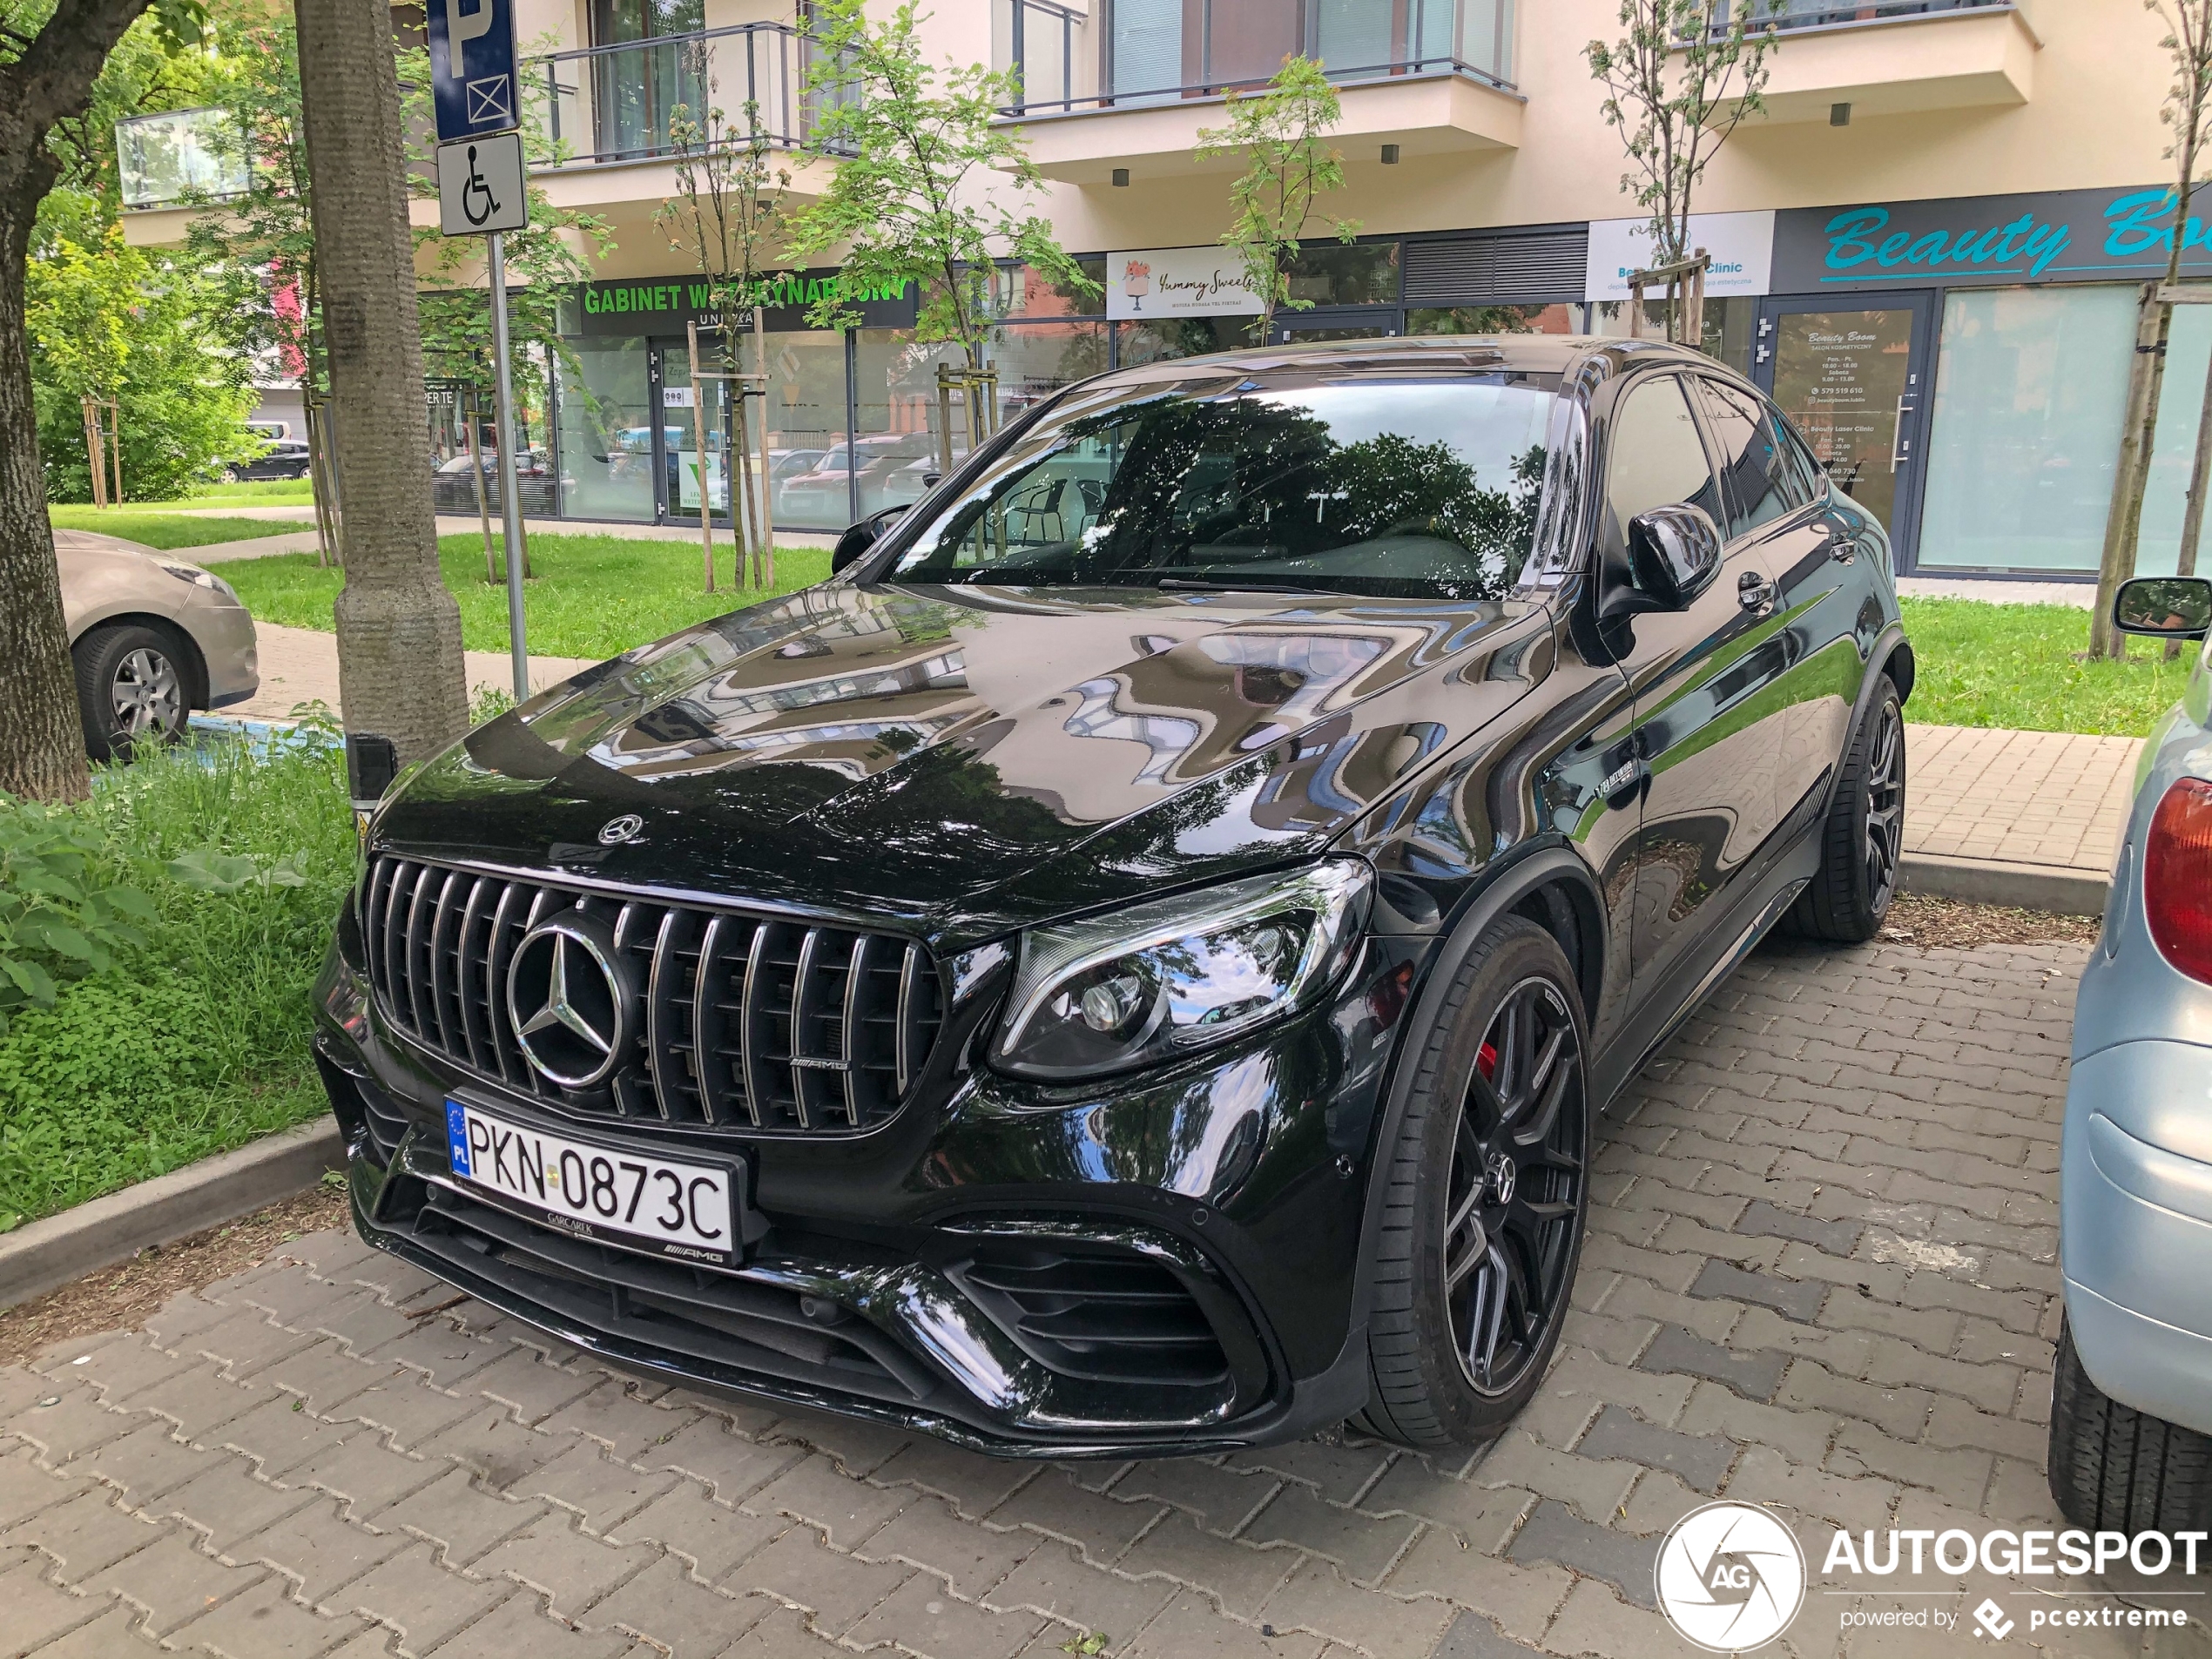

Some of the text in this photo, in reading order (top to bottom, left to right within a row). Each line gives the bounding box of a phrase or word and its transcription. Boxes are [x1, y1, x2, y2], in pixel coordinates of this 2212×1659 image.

[1824, 189, 2212, 278] Beauty Bo
[1705, 262, 1743, 273] Clinic
[1159, 273, 1209, 300] Yummy
[585, 286, 681, 314] GABINET
[1808, 331, 1877, 343] Beauty Boom
[441, 391, 454, 404] TE
[1594, 779, 1610, 799] V8
[806, 1059, 848, 1070] AMG
[454, 1145, 468, 1164] PL
[469, 1117, 722, 1239] PKN 0873C
[681, 1246, 724, 1263] AMG
